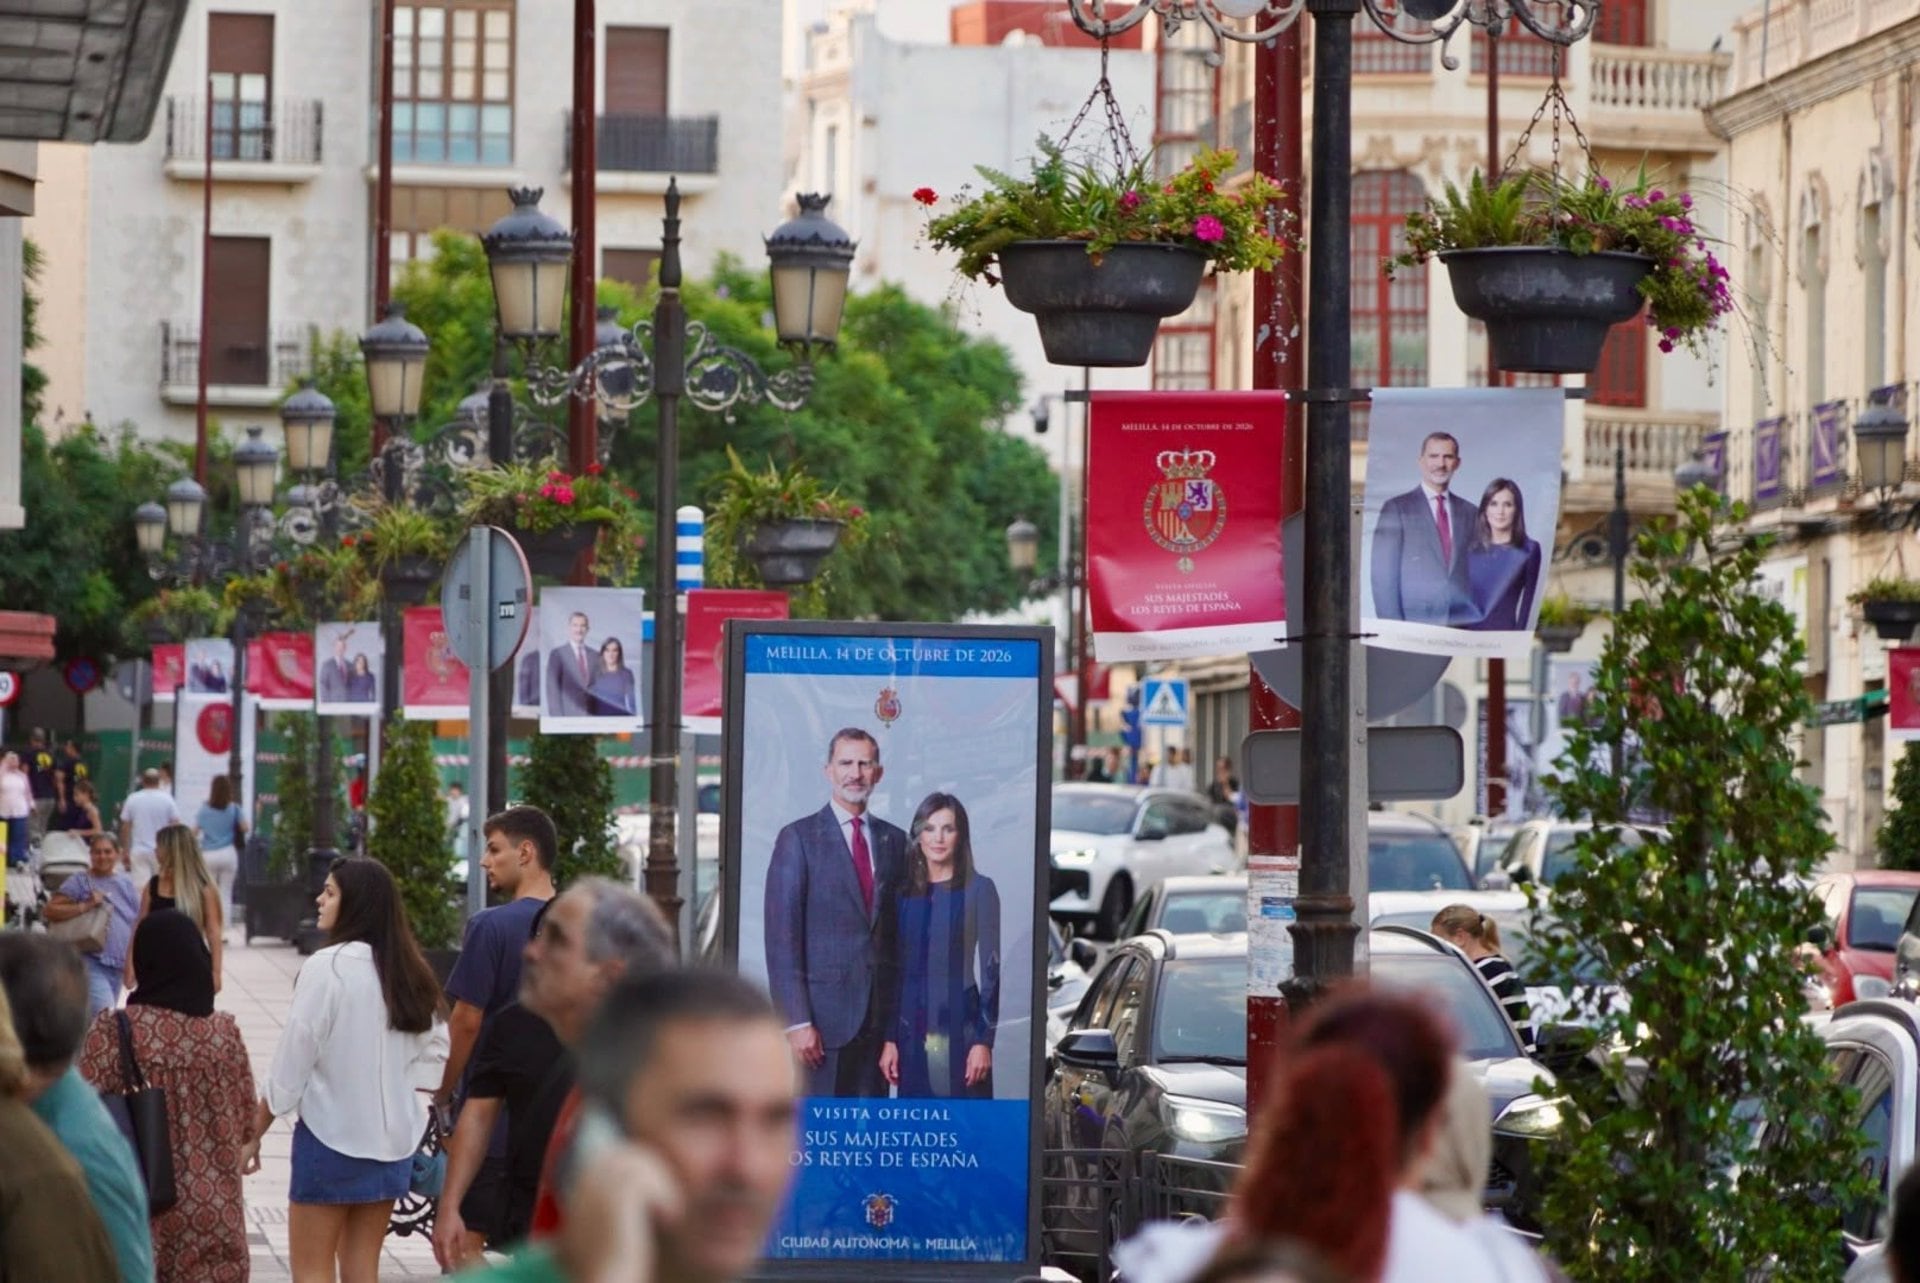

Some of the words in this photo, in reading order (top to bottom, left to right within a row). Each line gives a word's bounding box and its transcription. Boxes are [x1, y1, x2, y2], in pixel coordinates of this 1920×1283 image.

[1166, 592, 1229, 604] MAJESTADES
[1153, 604, 1182, 614] REYES
[1186, 604, 1200, 612] DE
[1203, 601, 1242, 612] ESPAÑA
[837, 647, 849, 661] 14
[855, 648, 874, 661] DE
[879, 648, 950, 662] OCTUBRE
[955, 649, 976, 662] DE
[980, 649, 1012, 663] 2026
[813, 1107, 871, 1120] VISITA
[878, 1108, 951, 1121] OFICIAL
[805, 1130, 838, 1146] SUS
[844, 1131, 958, 1149] MAJESTADES
[787, 1151, 813, 1167] OS
[819, 1151, 873, 1167] REYES
[880, 1152, 904, 1167] DE
[911, 1150, 979, 1168] ESPAÑA
[781, 1236, 830, 1249] CIUDAD
[925, 1238, 977, 1250] MELILLA
